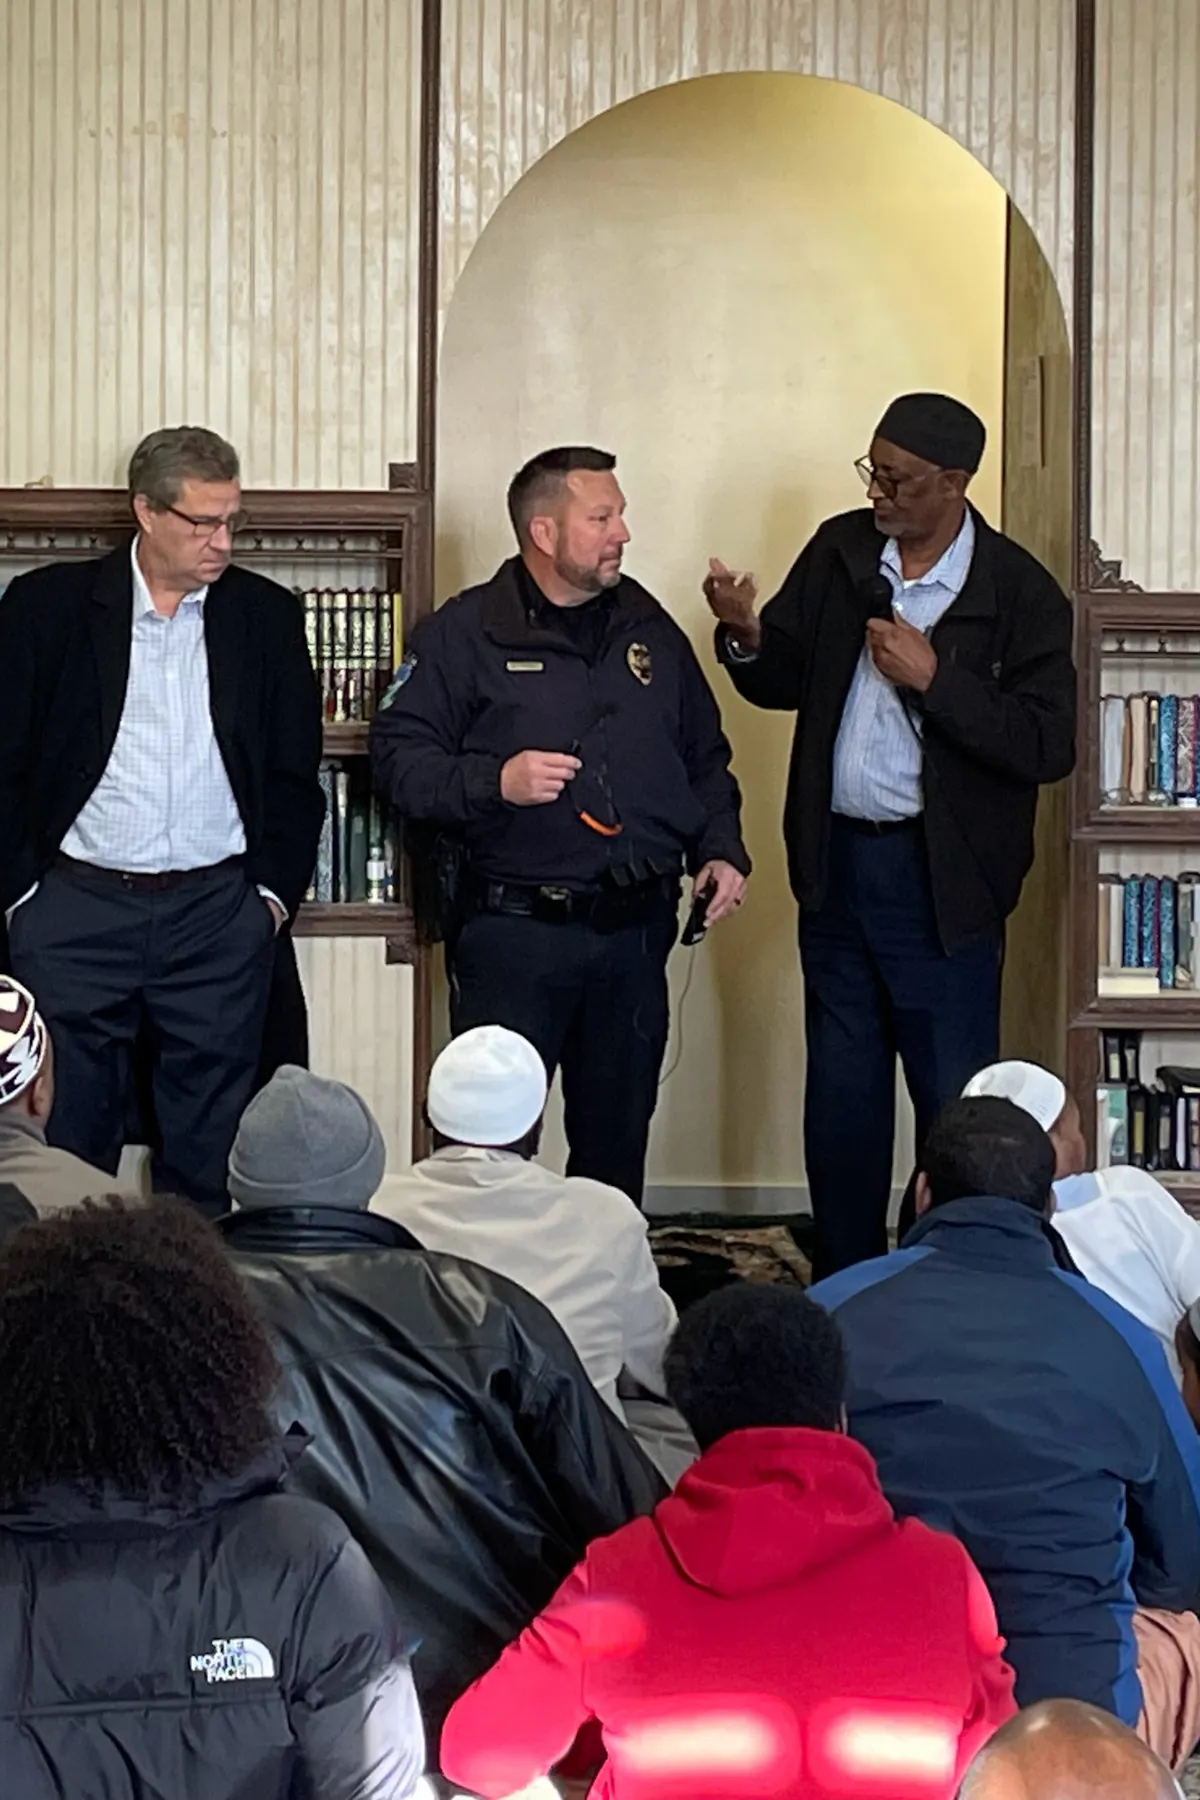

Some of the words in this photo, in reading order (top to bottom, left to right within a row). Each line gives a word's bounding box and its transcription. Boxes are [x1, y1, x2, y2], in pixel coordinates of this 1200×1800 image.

[211, 1639, 245, 1654] THE
[190, 1653, 246, 1672] NORTH
[206, 1667, 247, 1684] FACE
